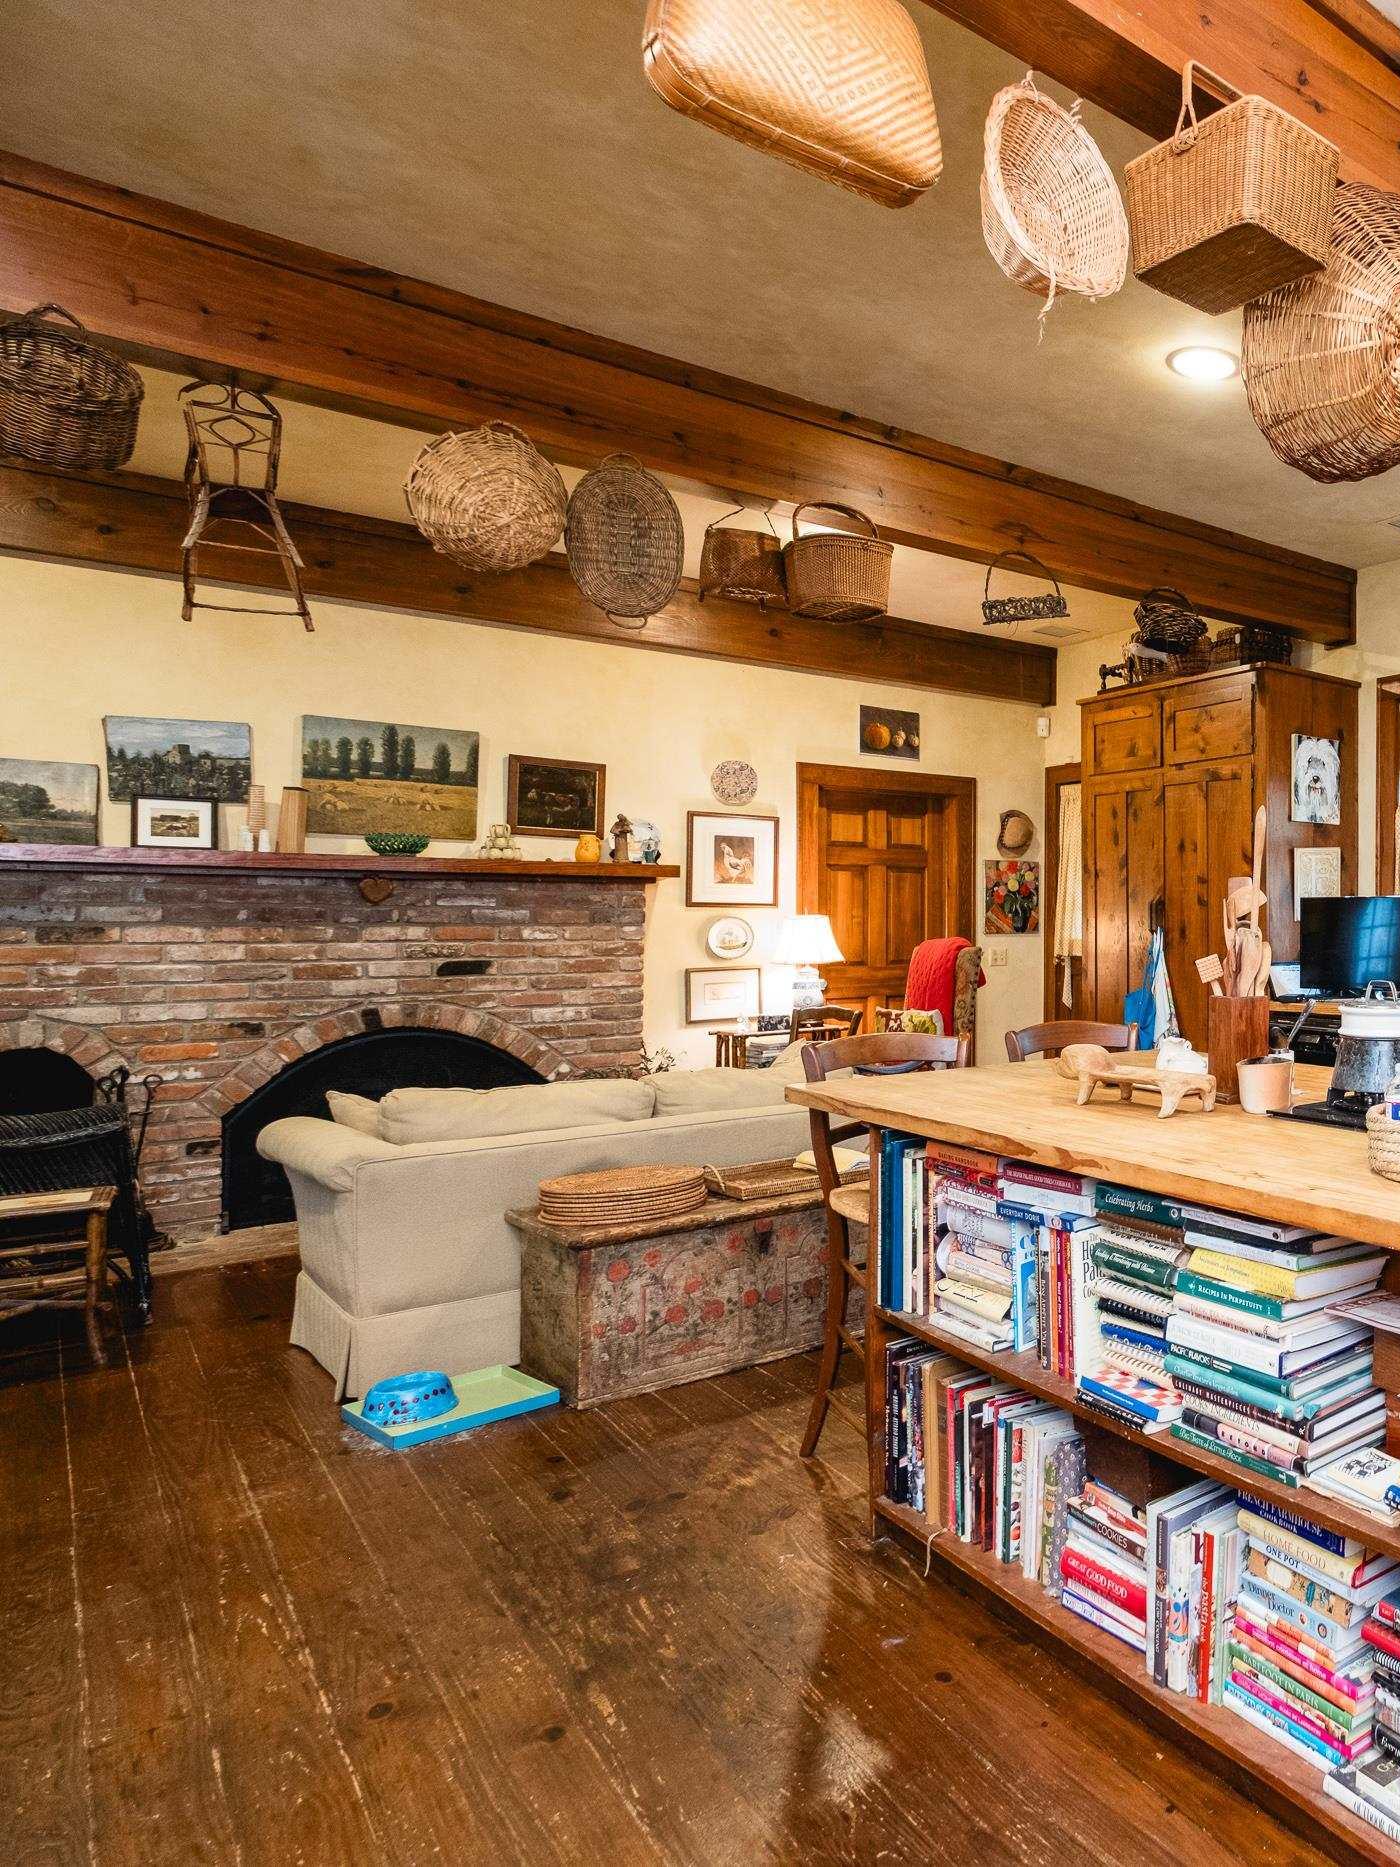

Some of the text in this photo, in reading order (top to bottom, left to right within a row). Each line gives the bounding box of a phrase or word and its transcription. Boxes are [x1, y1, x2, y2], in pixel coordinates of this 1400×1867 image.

[999, 1205, 1023, 1219] EVERYDAY
[1024, 1211, 1040, 1223] DORIE
[1105, 1193, 1154, 1213] Celebrating Herbs
[1170, 1343, 1188, 1357] PACIFIC
[1188, 1349, 1210, 1365] FLAVORS
[1175, 1380, 1251, 1415] CULINARY MASTERPIECES
[1096, 1520, 1128, 1550] COOKIES
[1262, 1529, 1326, 1569] HOME FOOD
[1265, 1544, 1299, 1569] ONE POT
[1085, 1566, 1107, 1587] GOOD
[1106, 1578, 1128, 1600] FOOD
[1242, 1653, 1284, 1688] BAREFOOT
[1295, 1687, 1319, 1709] PARIS
